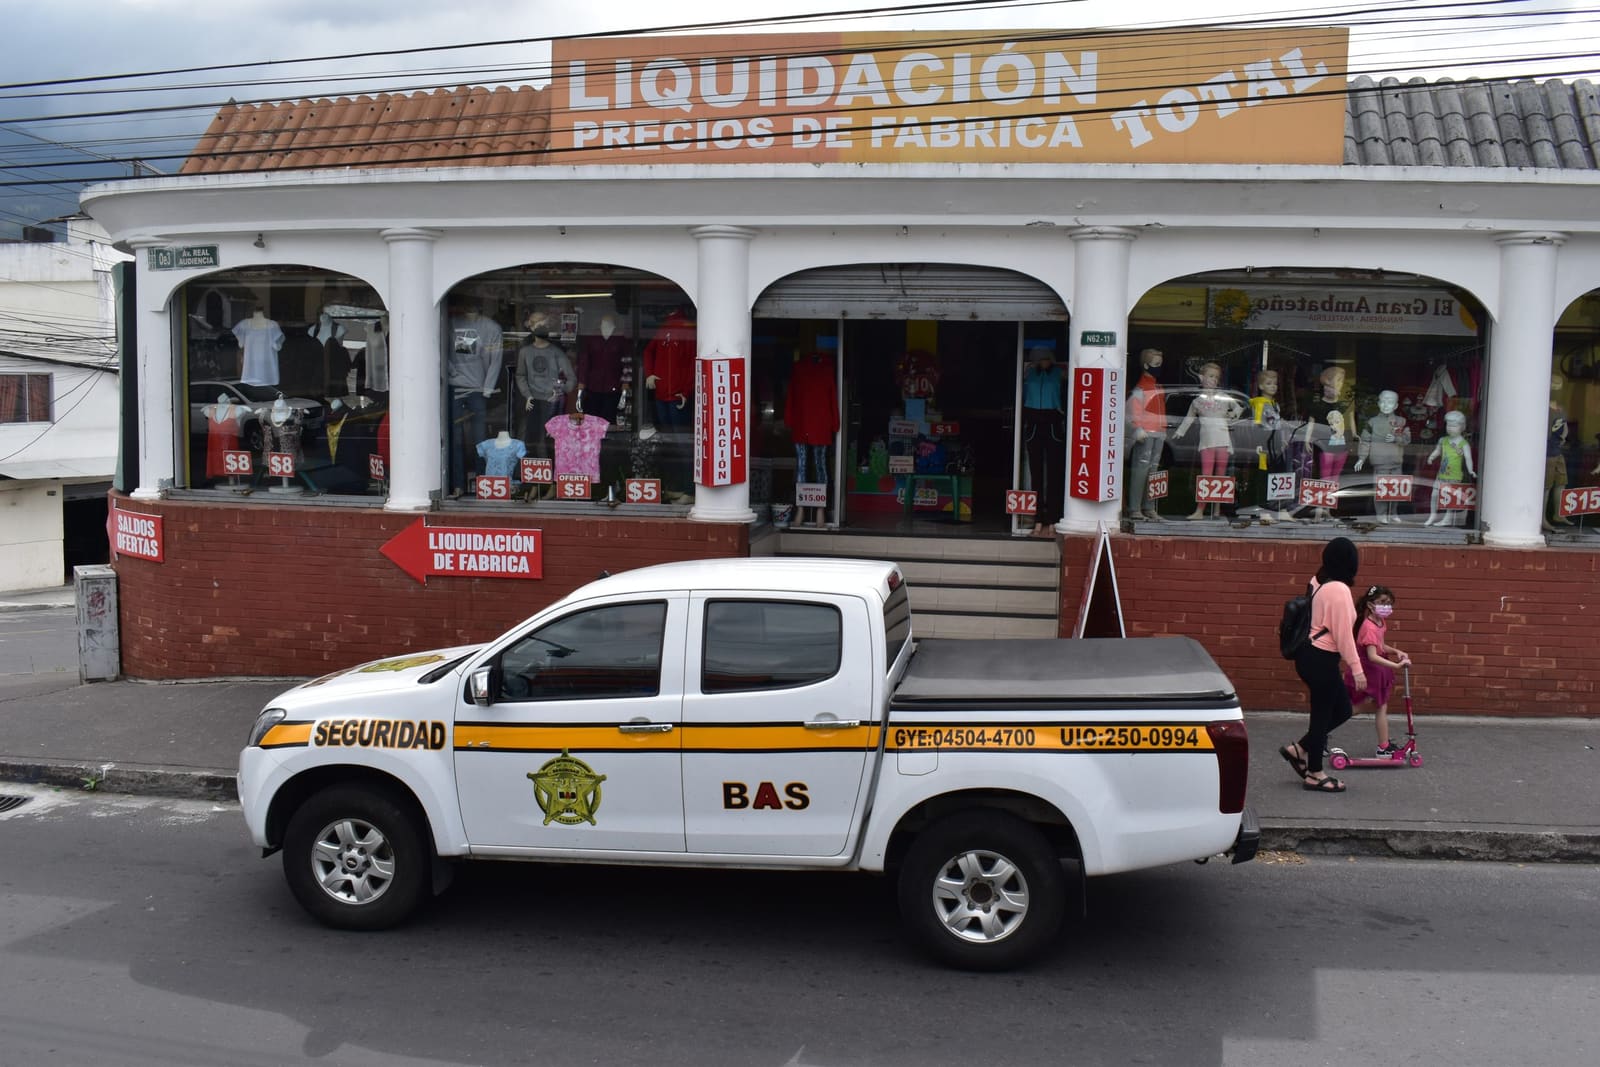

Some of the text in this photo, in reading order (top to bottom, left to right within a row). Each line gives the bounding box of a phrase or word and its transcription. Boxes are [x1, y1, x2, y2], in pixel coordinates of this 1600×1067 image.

[569, 42, 1098, 113] LIQUIDACIÓN
[1111, 48, 1329, 149] TOTAL
[573, 115, 1084, 150] PRECIOS DE FABRICA
[178, 256, 214, 265] AUDIENCIA
[193, 248, 211, 256] REAL
[1086, 335, 1111, 344] N62-11
[731, 373, 742, 458] TOTAL
[1078, 372, 1093, 495] OFERTAS
[1106, 371, 1118, 499] DESCUENTOS
[226, 453, 250, 473] $8
[271, 456, 293, 475] $8
[369, 457, 384, 477] $25
[523, 459, 551, 467] OFERTA
[524, 467, 552, 482] $40
[1271, 476, 1293, 494] $25
[478, 478, 507, 499] $5
[564, 483, 585, 498] $5
[627, 482, 657, 502] $5
[1148, 481, 1167, 498] $30
[1198, 479, 1235, 500] $22
[1302, 489, 1337, 506] $15
[1376, 478, 1412, 499] $30
[1439, 485, 1476, 507] $12
[1008, 493, 1037, 512] $12
[118, 514, 155, 538] SALDOS
[117, 532, 158, 557] OFERTAS
[429, 532, 535, 553] LIQUIDACIÓN
[434, 553, 530, 573] DE FABRICA
[314, 719, 447, 751] SEGURIDAD
[895, 727, 1199, 748] GYE:04504-4700 UIO:250-0994
[722, 781, 810, 811] BAS
